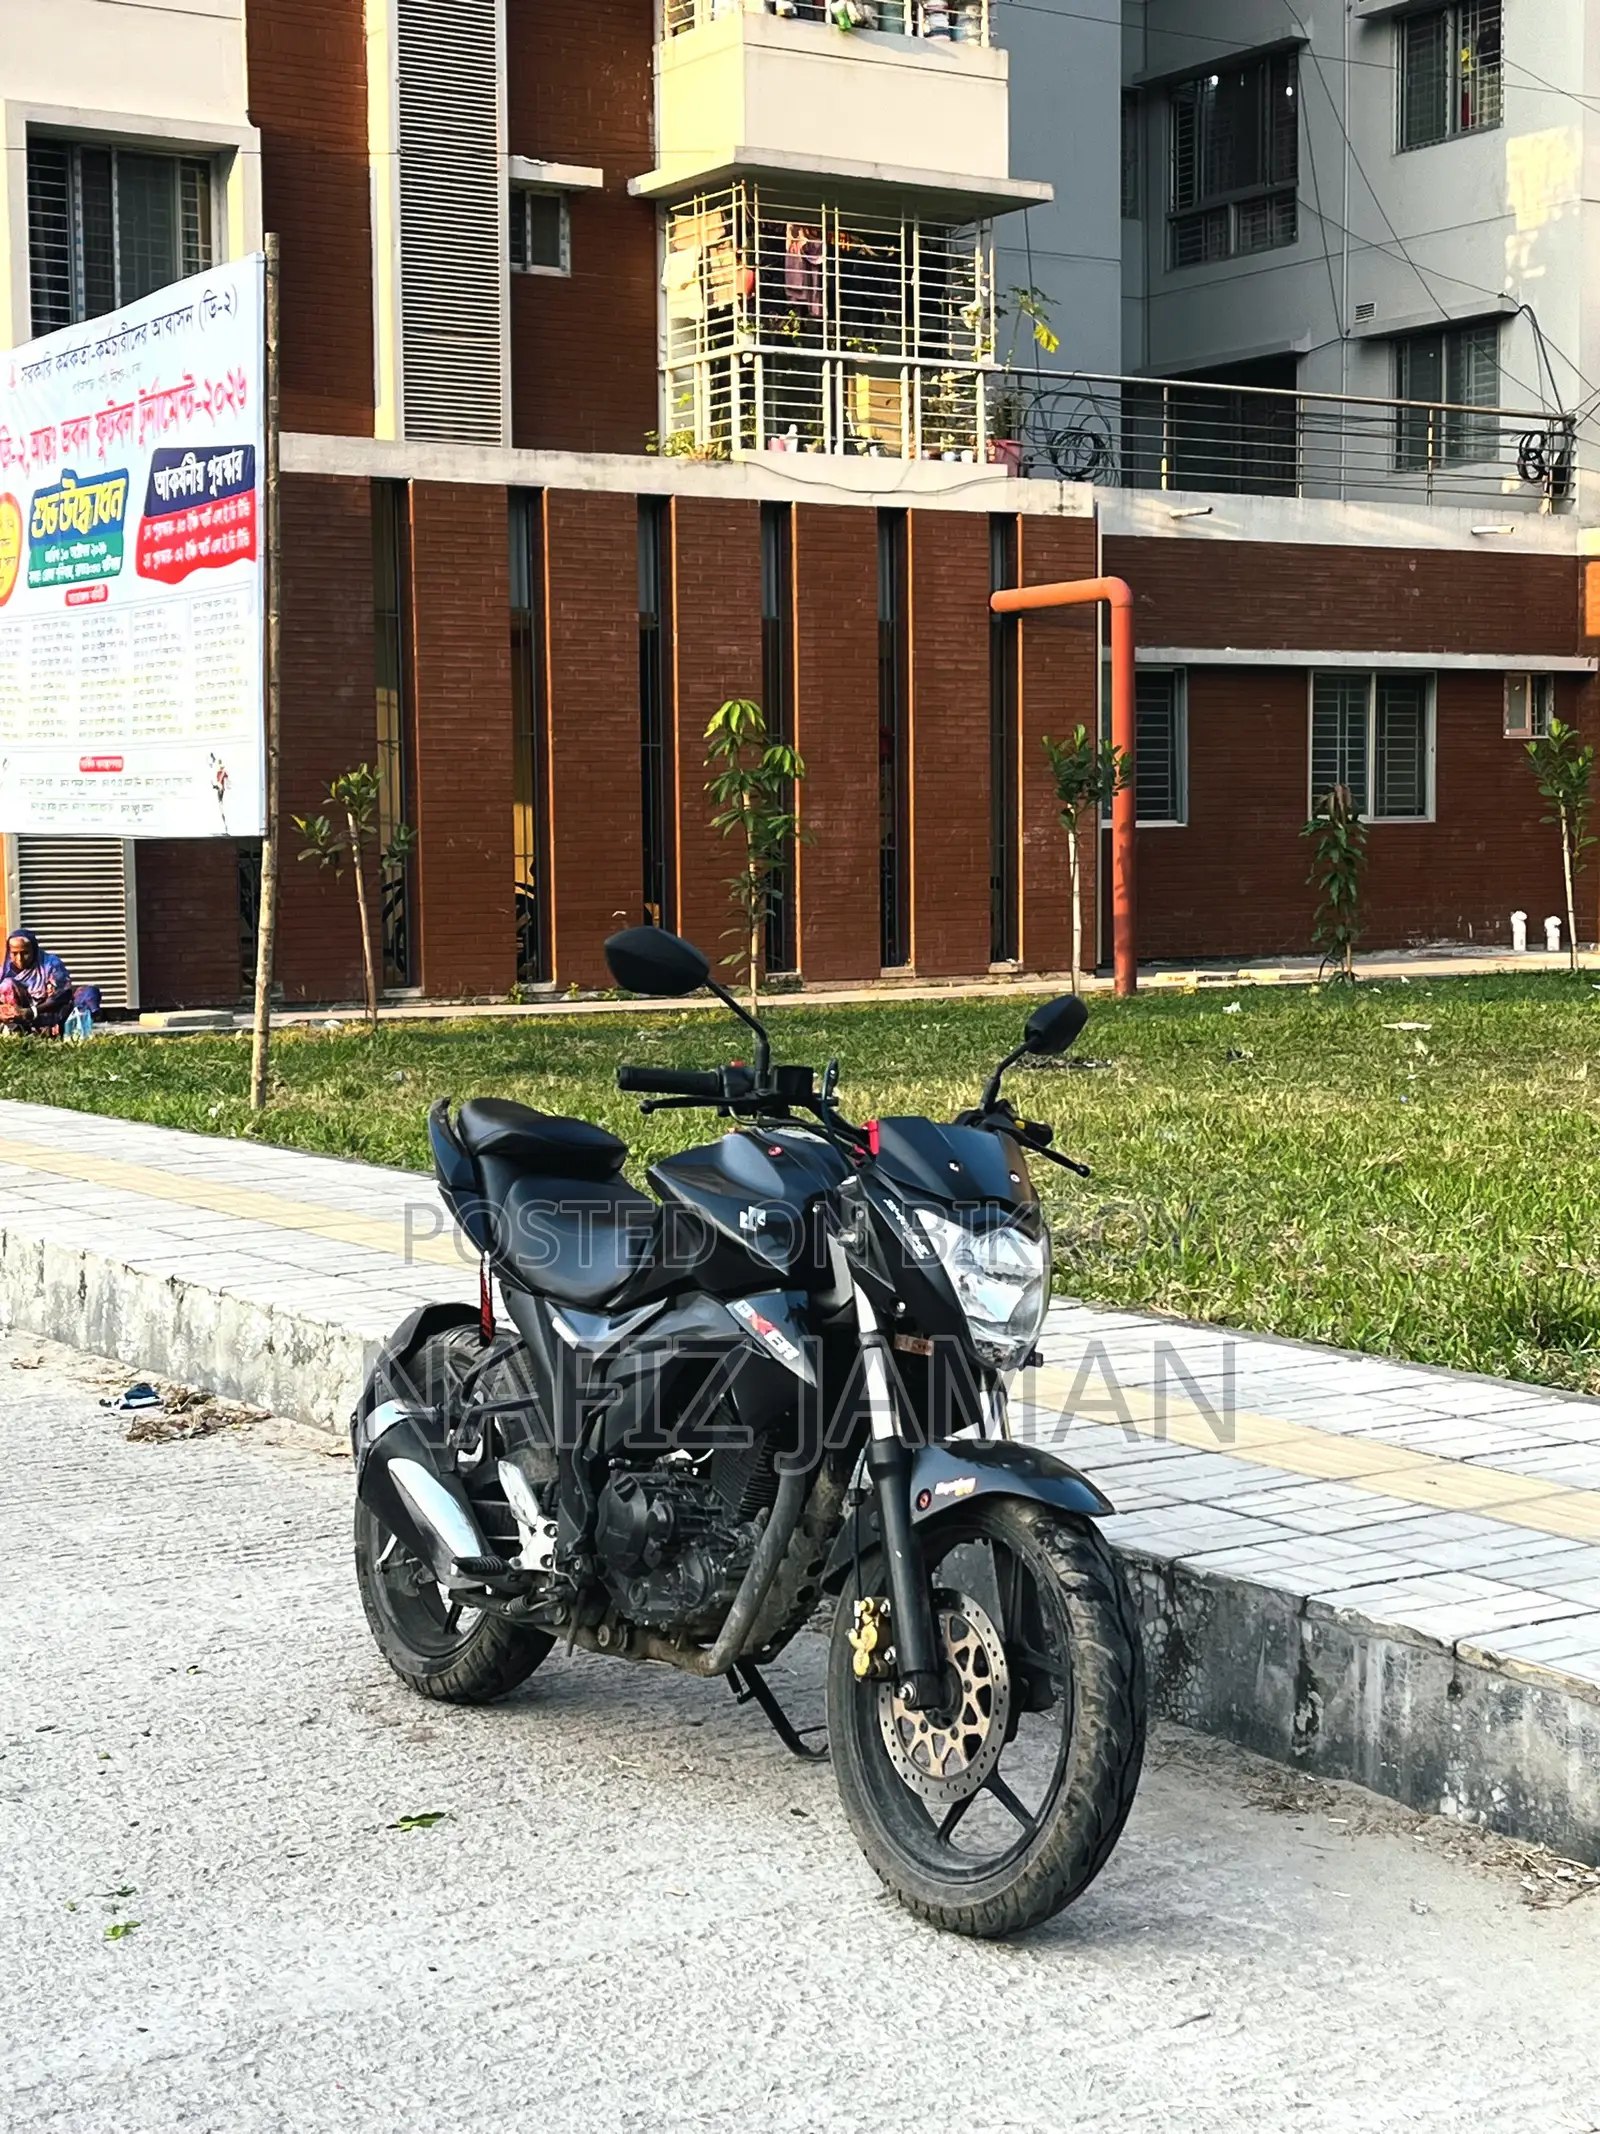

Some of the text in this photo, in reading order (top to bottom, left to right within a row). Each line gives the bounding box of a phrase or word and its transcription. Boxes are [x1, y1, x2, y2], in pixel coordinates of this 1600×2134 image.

[151, 304, 194, 341] আবাসন
[198, 283, 238, 332] (ডি-২)
[60, 415, 92, 459] ভবন
[95, 393, 135, 467] ফুটবল
[207, 448, 244, 498] পুরস্কার
